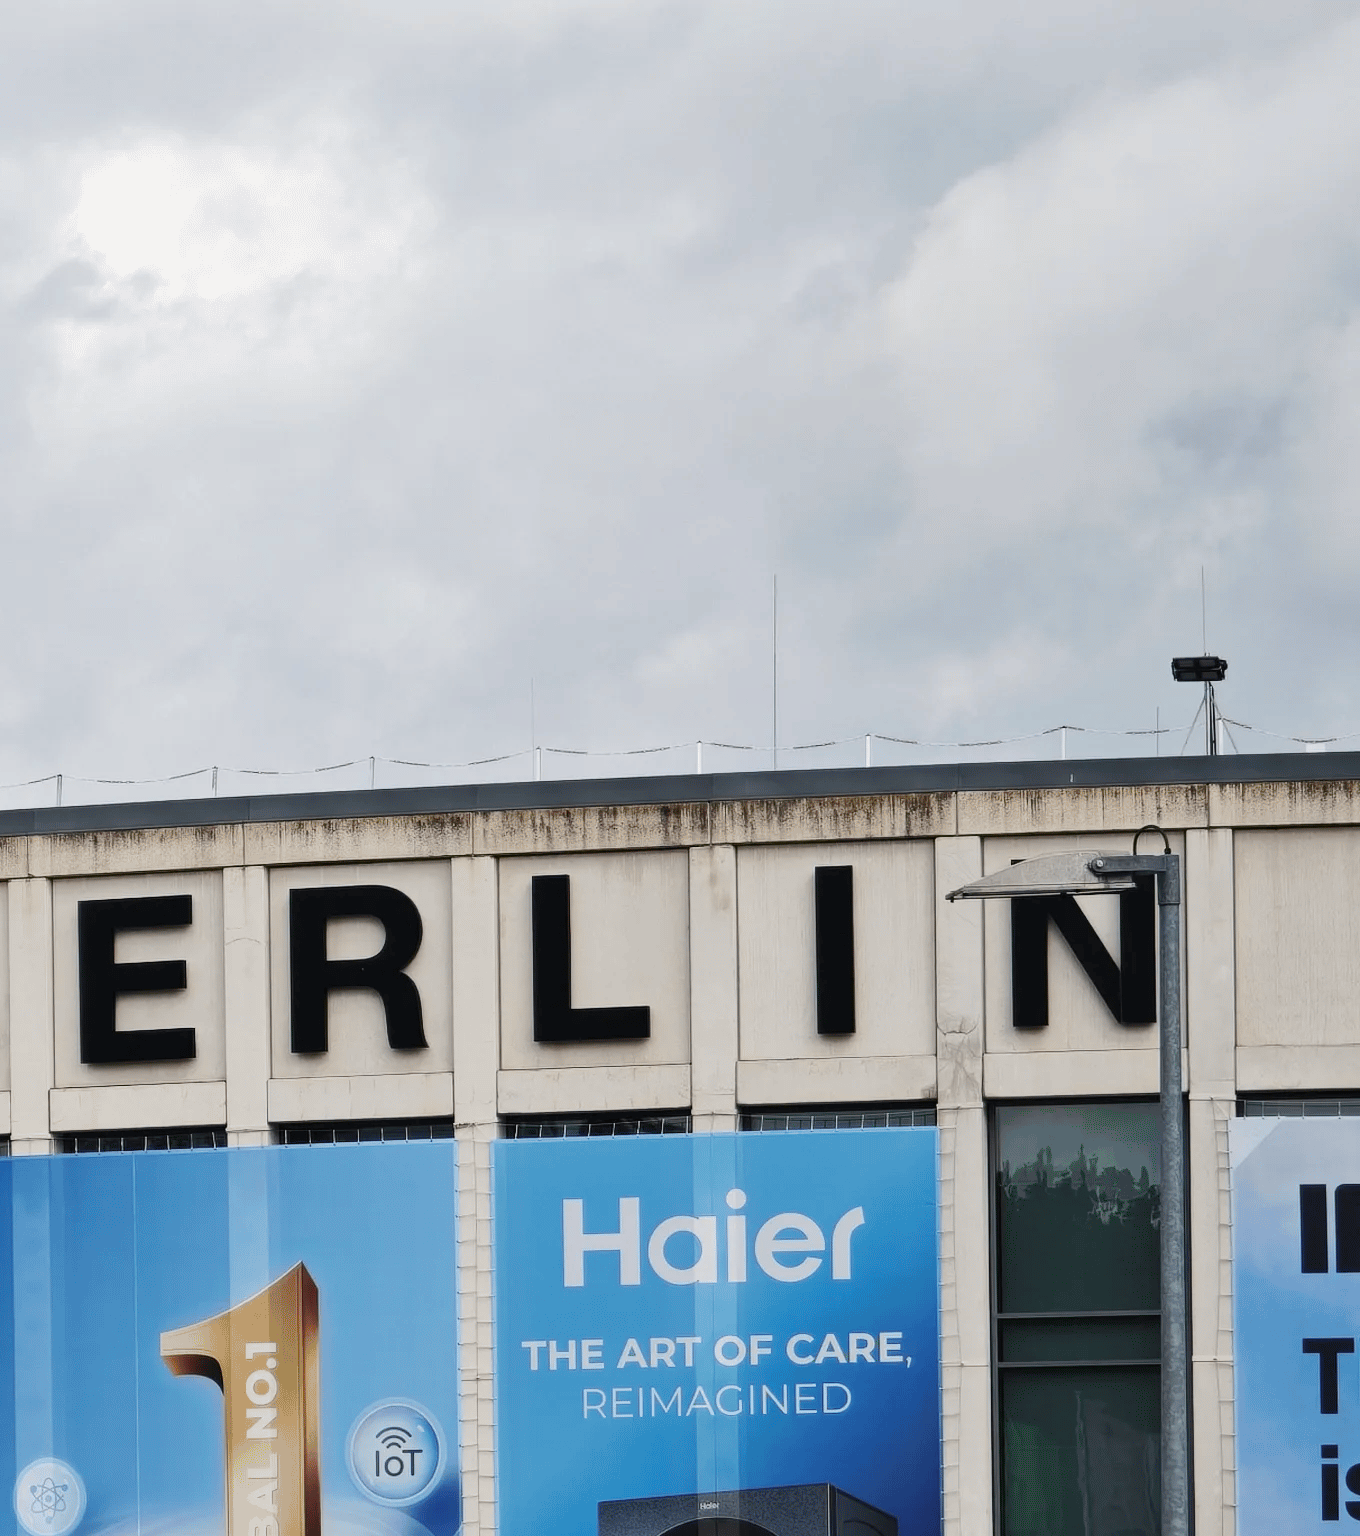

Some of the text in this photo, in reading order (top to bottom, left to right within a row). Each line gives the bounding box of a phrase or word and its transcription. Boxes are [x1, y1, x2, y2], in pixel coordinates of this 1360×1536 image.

[563, 1188, 866, 1287] Haier
[521, 1331, 912, 1371] THE ART OF CARE,
[246, 1341, 279, 1439] NO.1
[582, 1382, 852, 1419] REIMAGINED
[375, 1450, 423, 1477] IoT
